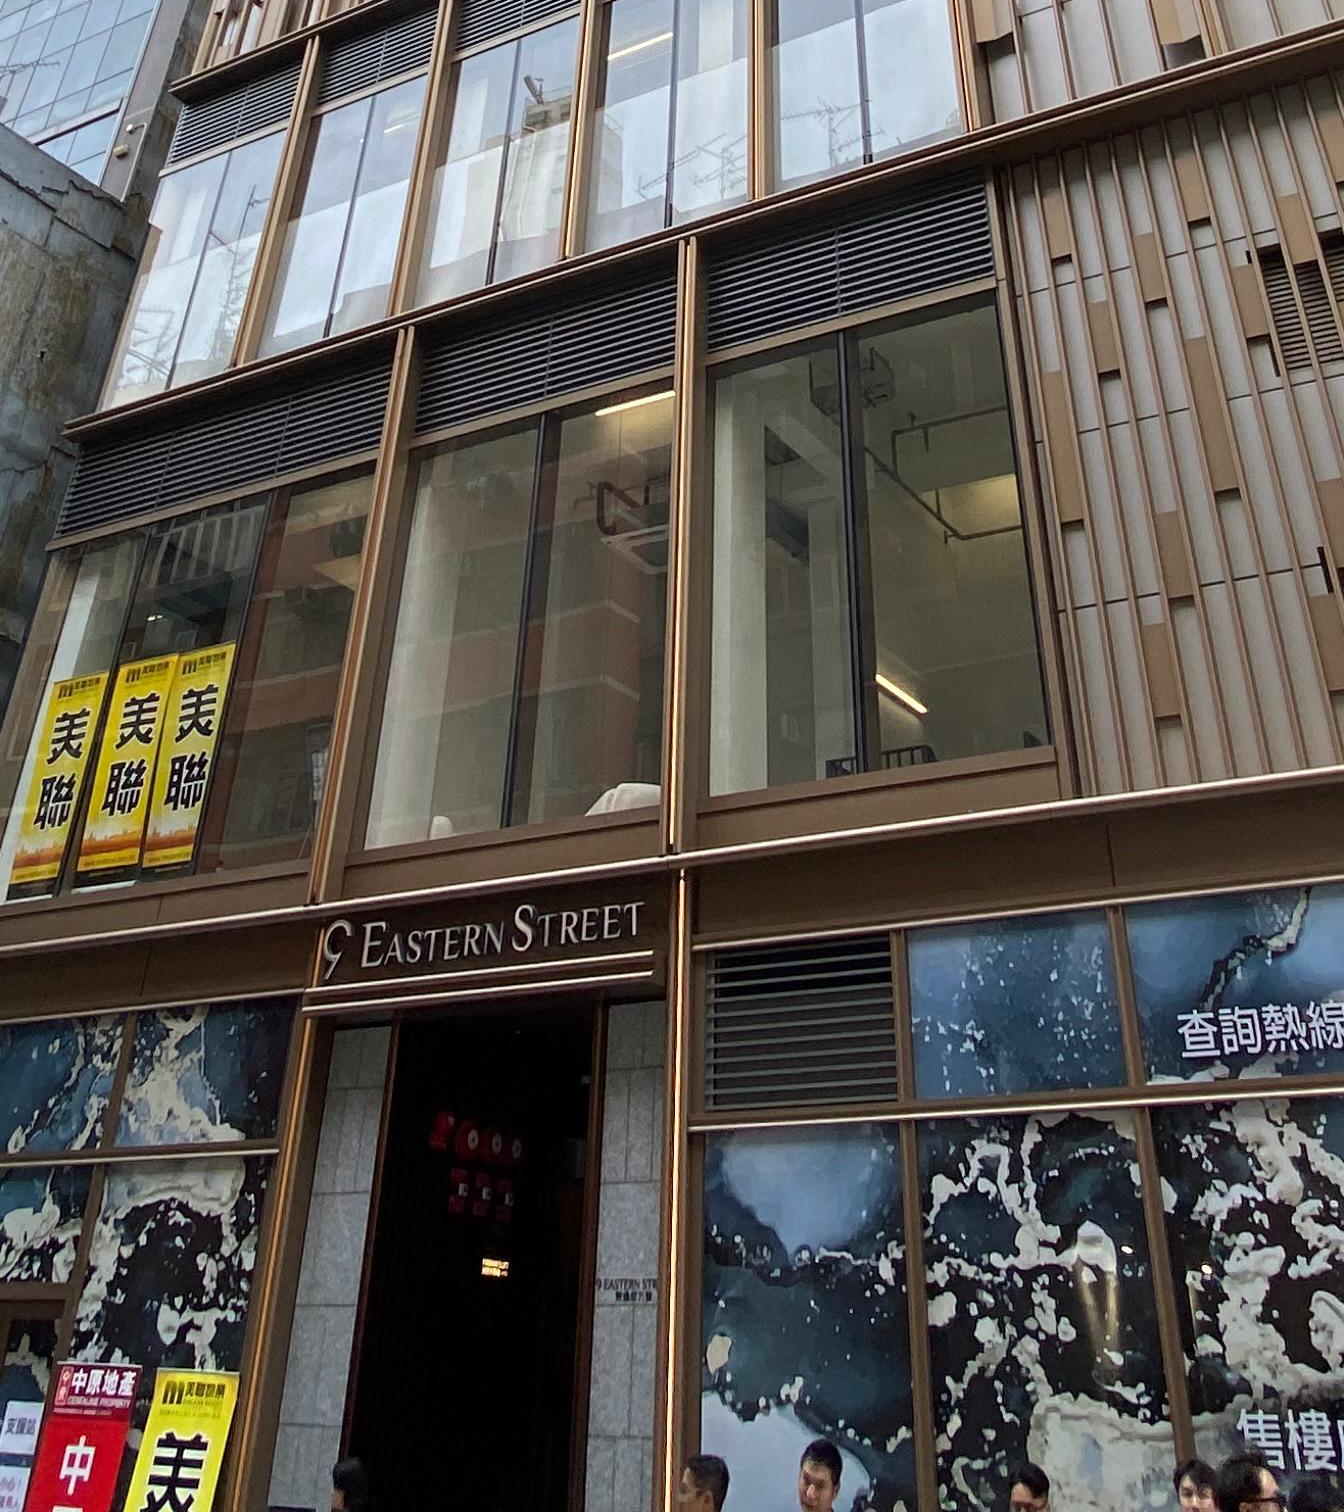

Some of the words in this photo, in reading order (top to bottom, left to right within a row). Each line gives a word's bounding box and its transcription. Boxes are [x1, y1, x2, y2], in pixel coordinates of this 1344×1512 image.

[34, 708, 90, 829] 美聯
[102, 692, 160, 816] 美聯
[164, 684, 219, 811] 美聯
[360, 921, 505, 968] EASTERN
[511, 901, 645, 952] STREET
[71, 1368, 136, 1396] 中原地產
